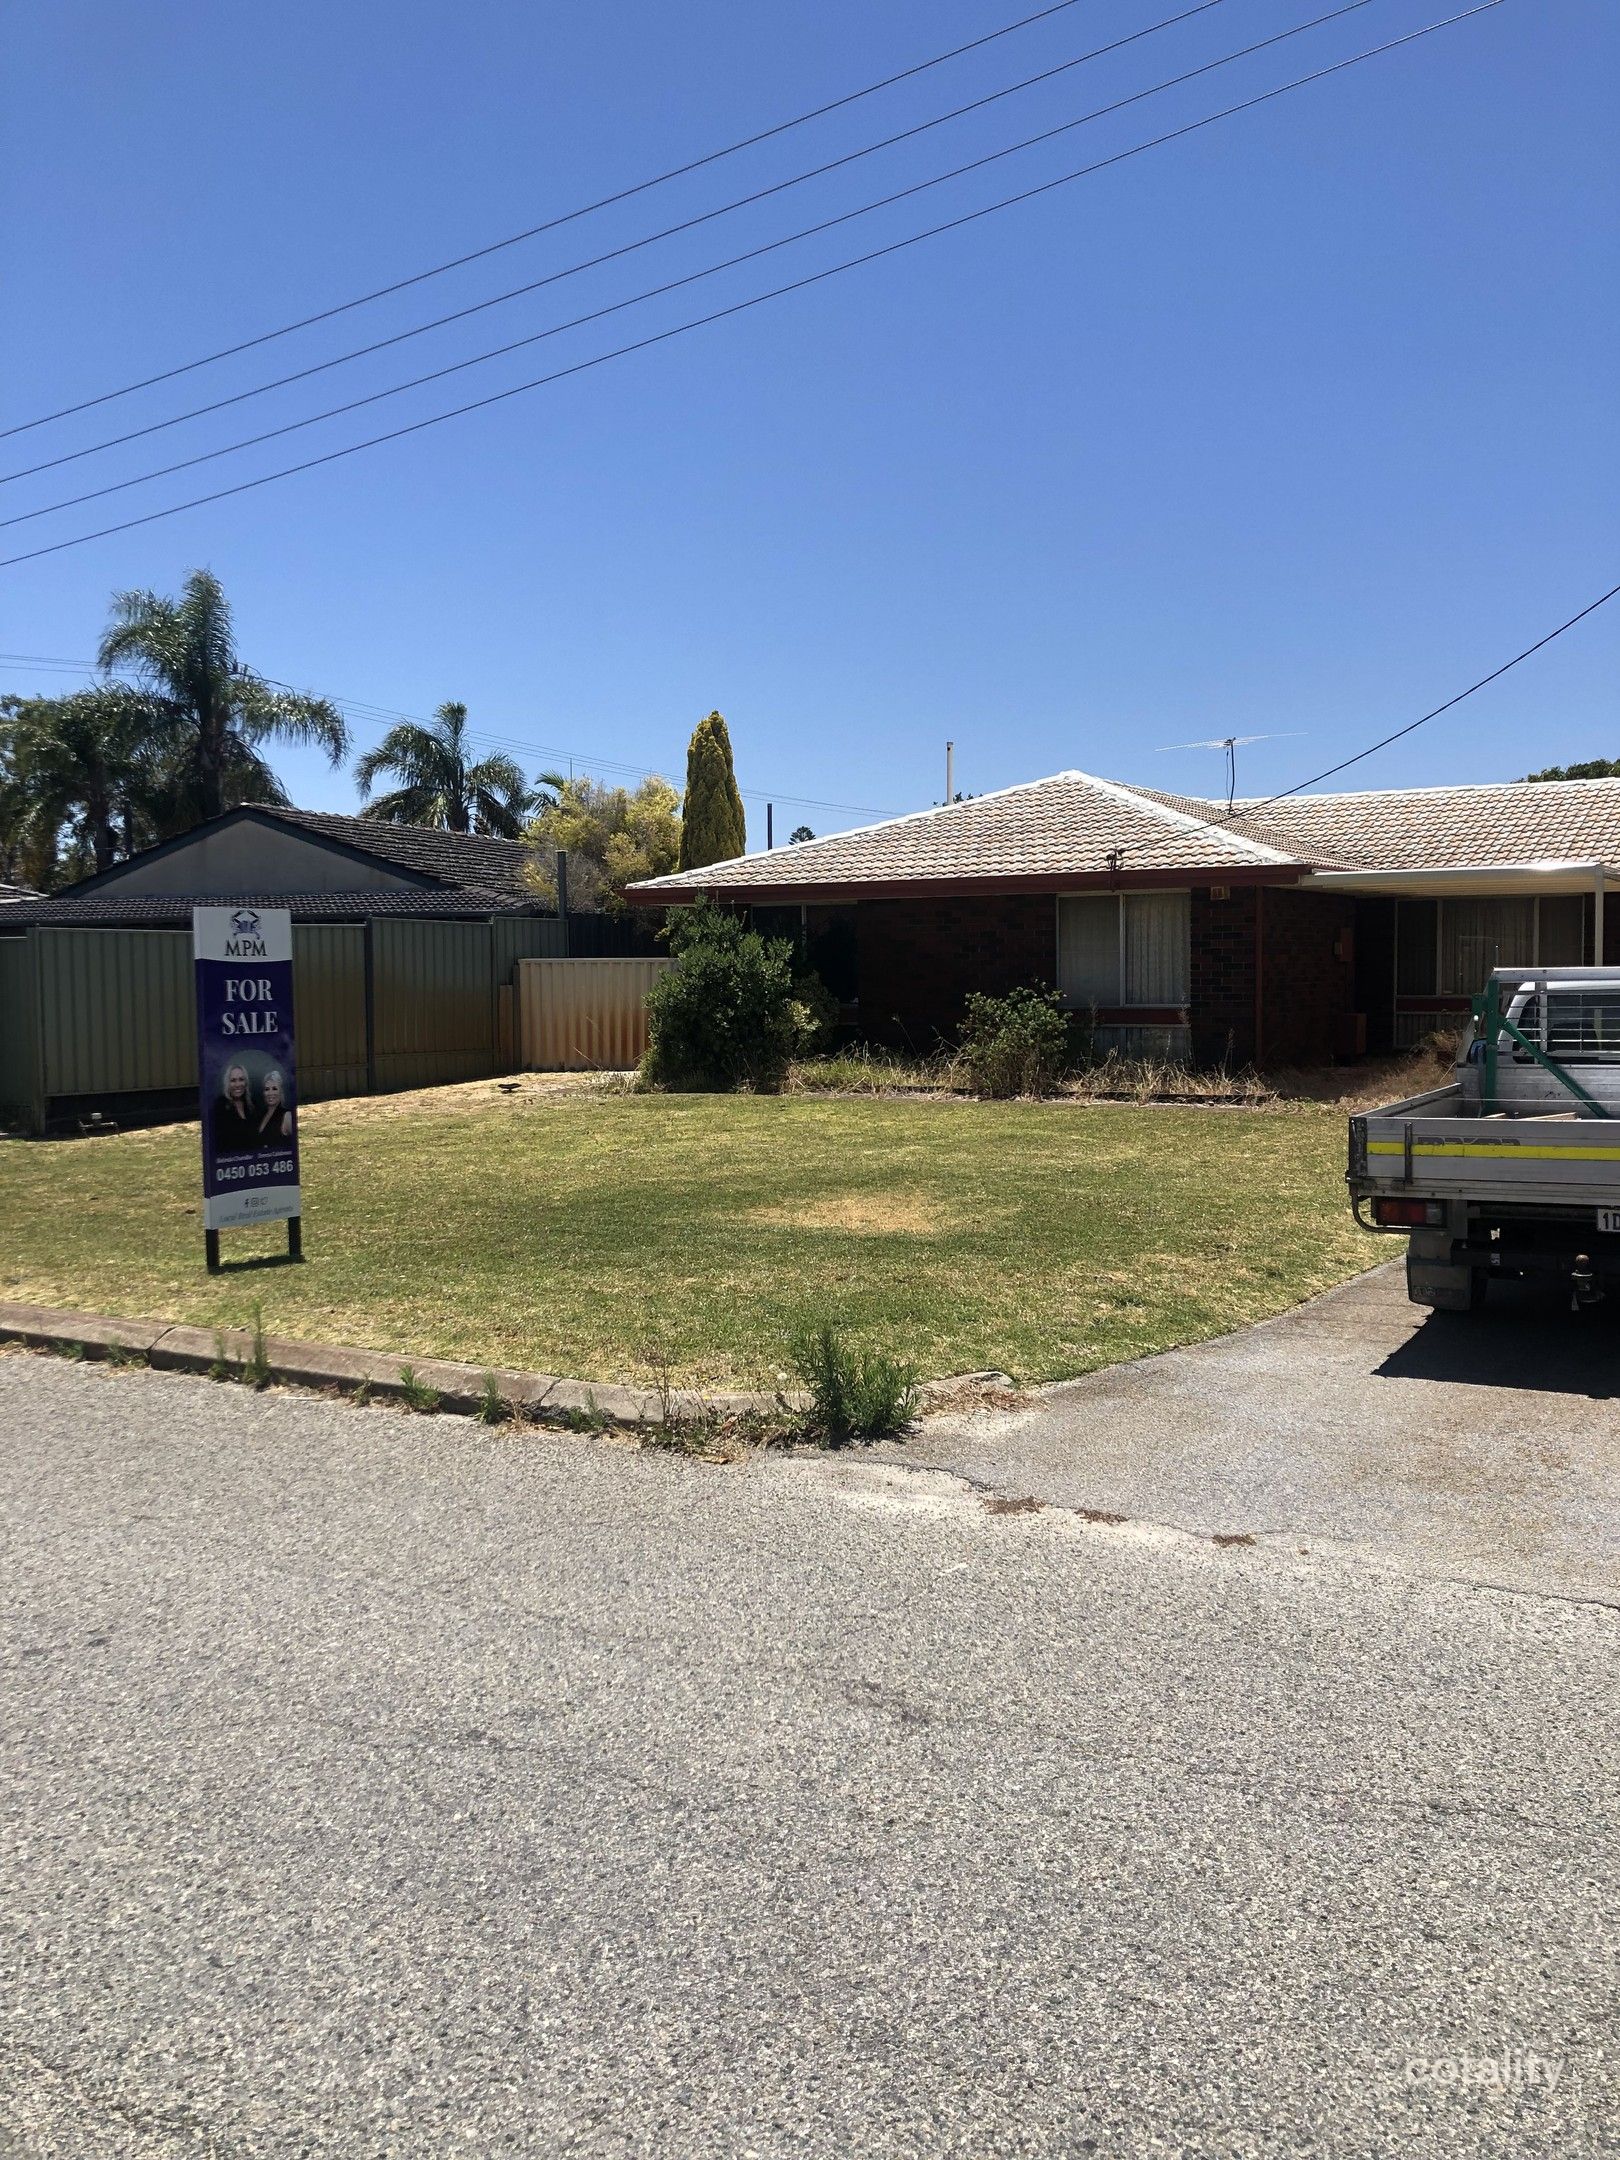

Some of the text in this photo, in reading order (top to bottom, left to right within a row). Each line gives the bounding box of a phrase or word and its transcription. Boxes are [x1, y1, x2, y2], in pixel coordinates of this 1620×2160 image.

[225, 940, 267, 956] MPM
[225, 979, 273, 1001] FOR
[222, 1011, 279, 1035] SALE
[216, 1160, 294, 1181] 0450 053 486
